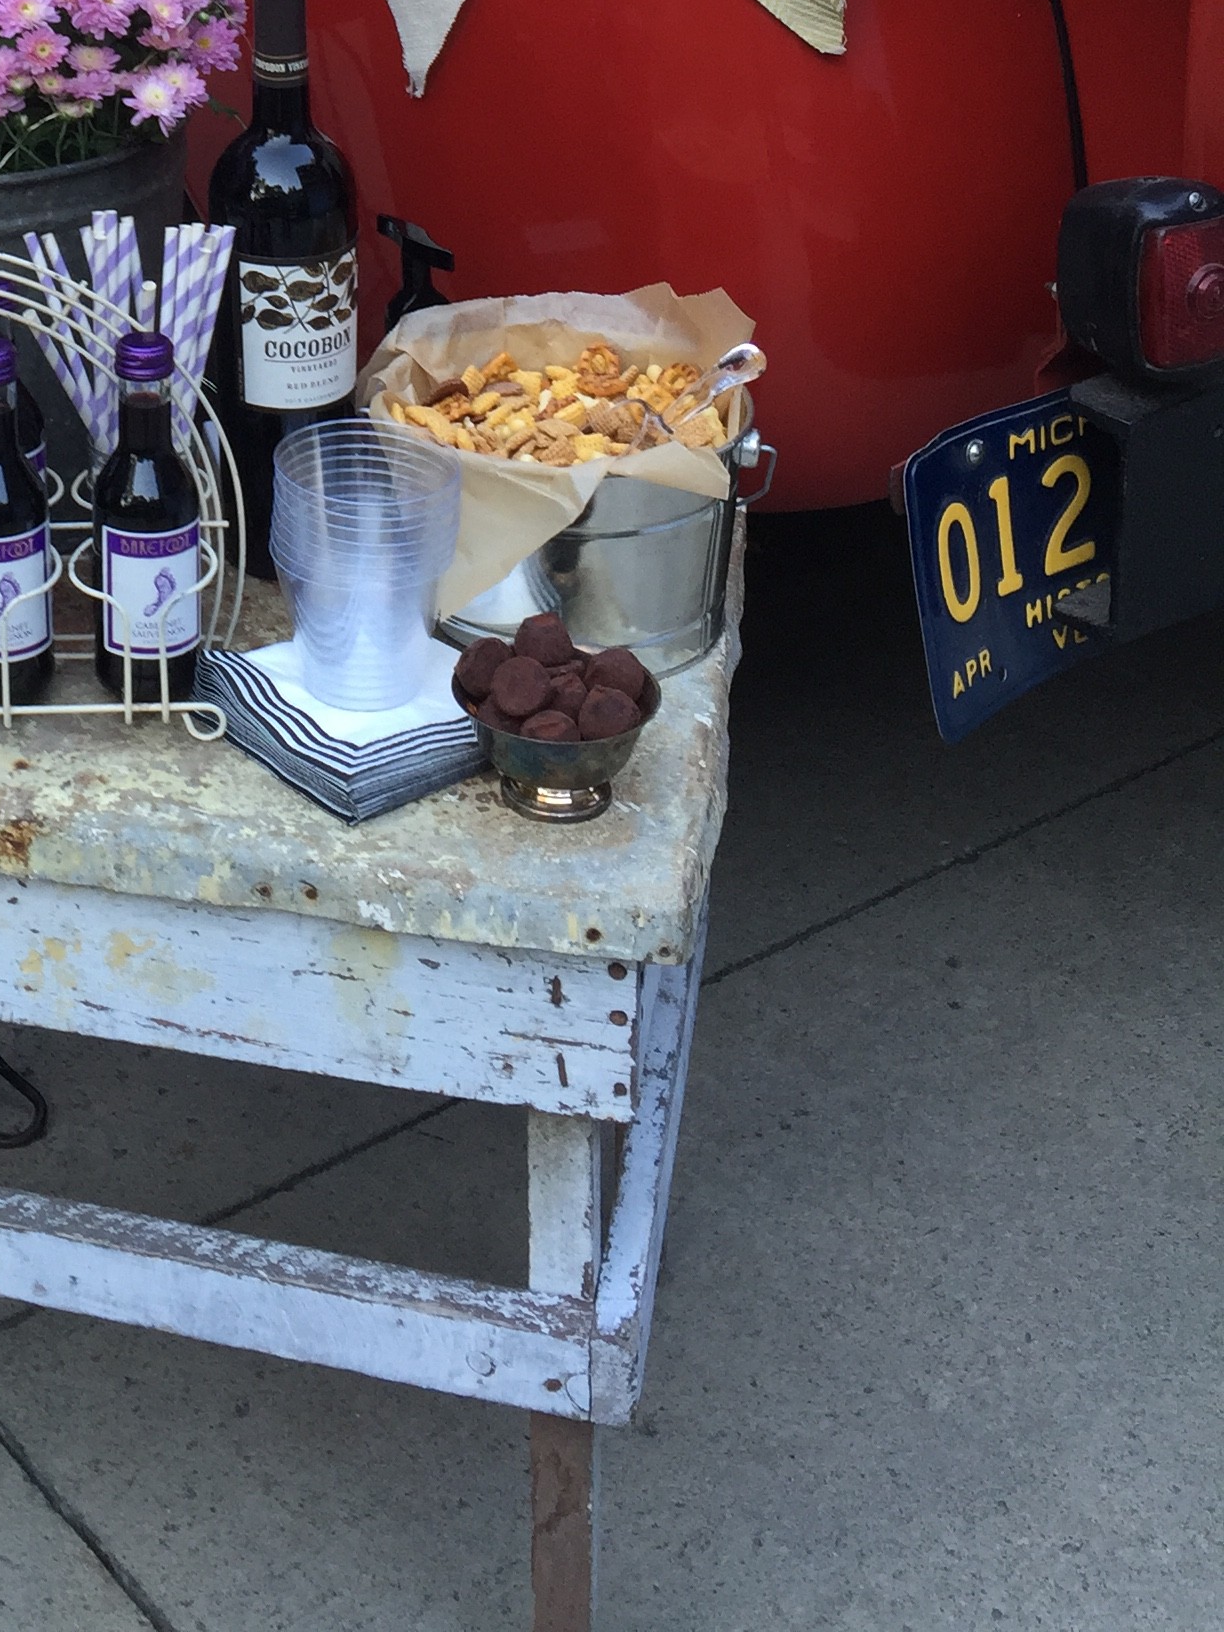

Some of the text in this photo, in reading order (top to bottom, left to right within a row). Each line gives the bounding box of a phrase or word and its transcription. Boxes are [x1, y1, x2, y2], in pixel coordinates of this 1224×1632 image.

[264, 326, 351, 359] COCOBON
[287, 382, 308, 390] RED
[119, 532, 191, 556] BAREFOOT
[938, 454, 1096, 624] 012
[952, 648, 993, 700] APR
